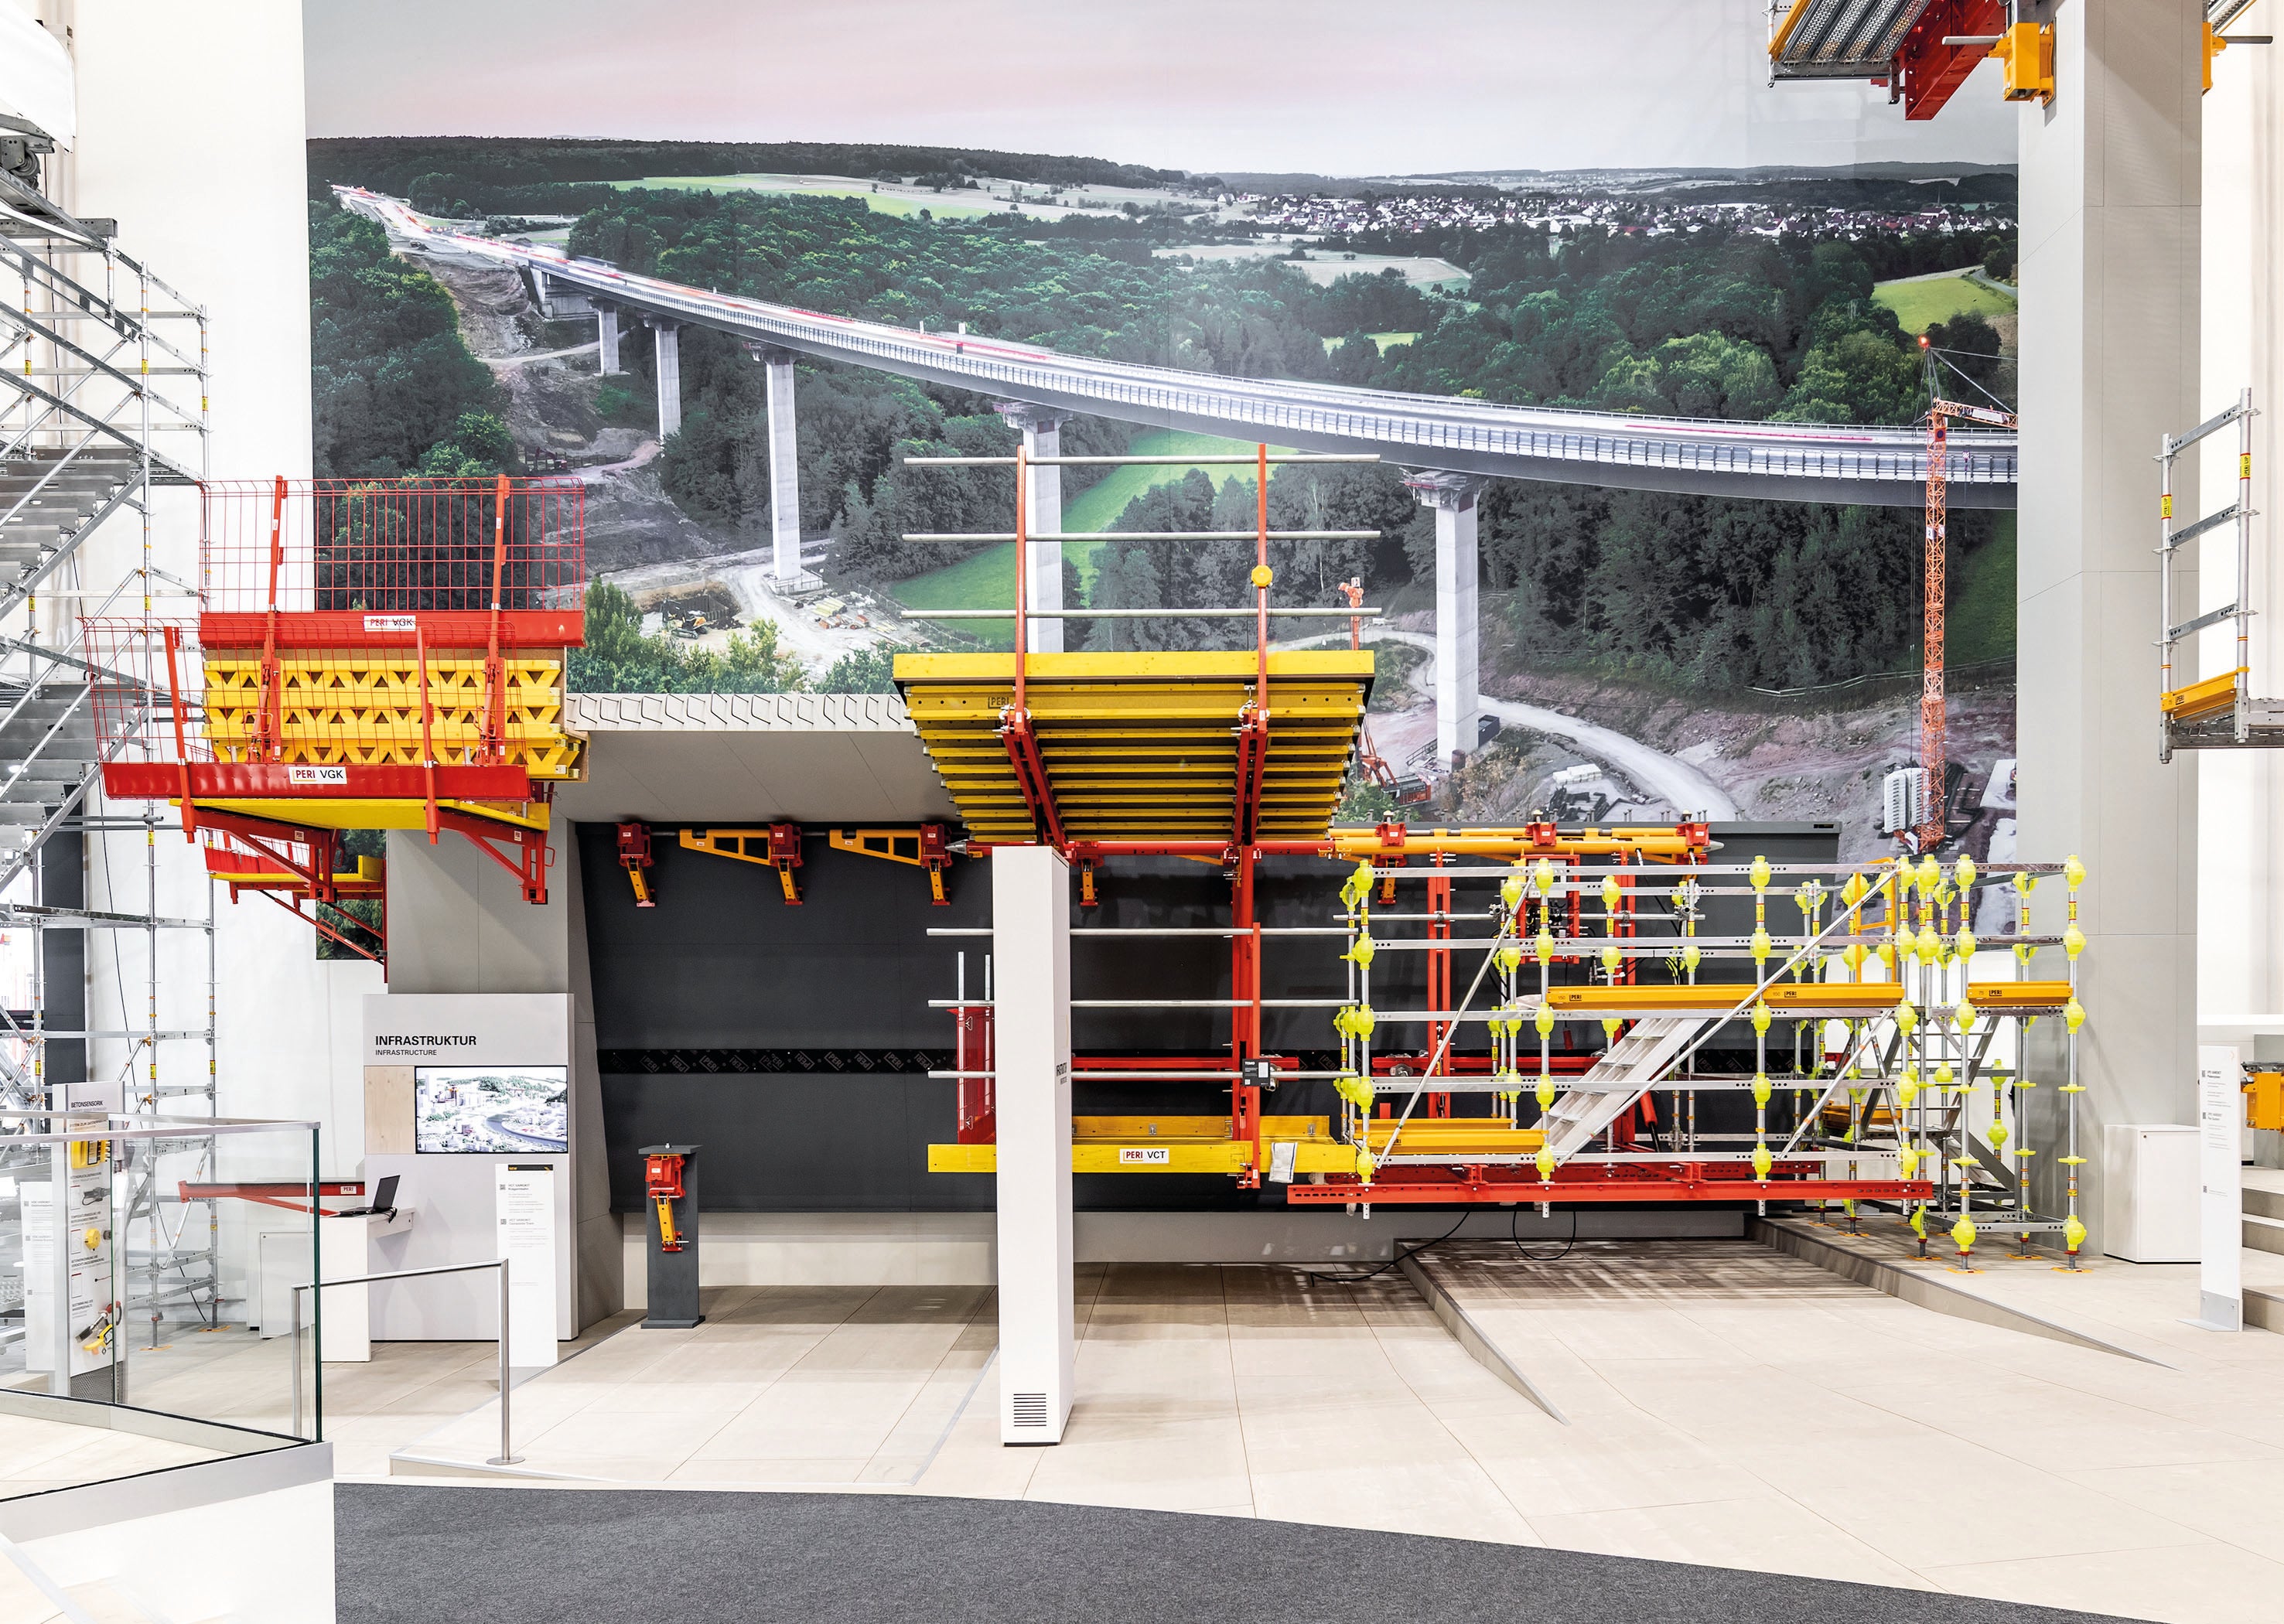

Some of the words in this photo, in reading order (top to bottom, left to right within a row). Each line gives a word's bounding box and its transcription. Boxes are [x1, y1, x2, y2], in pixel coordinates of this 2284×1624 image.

[991, 697, 1009, 705] PERI
[295, 769, 316, 779] PERI
[319, 769, 343, 779] VGK
[375, 1035, 477, 1046] INFRASTRUKTUR
[703, 1057, 719, 1072] PERI
[794, 1053, 811, 1068] PERI
[828, 1053, 845, 1069] PERI
[854, 1053, 871, 1068] PERI
[888, 1053, 904, 1069] PERI
[1147, 1151, 1166, 1159] VCT
